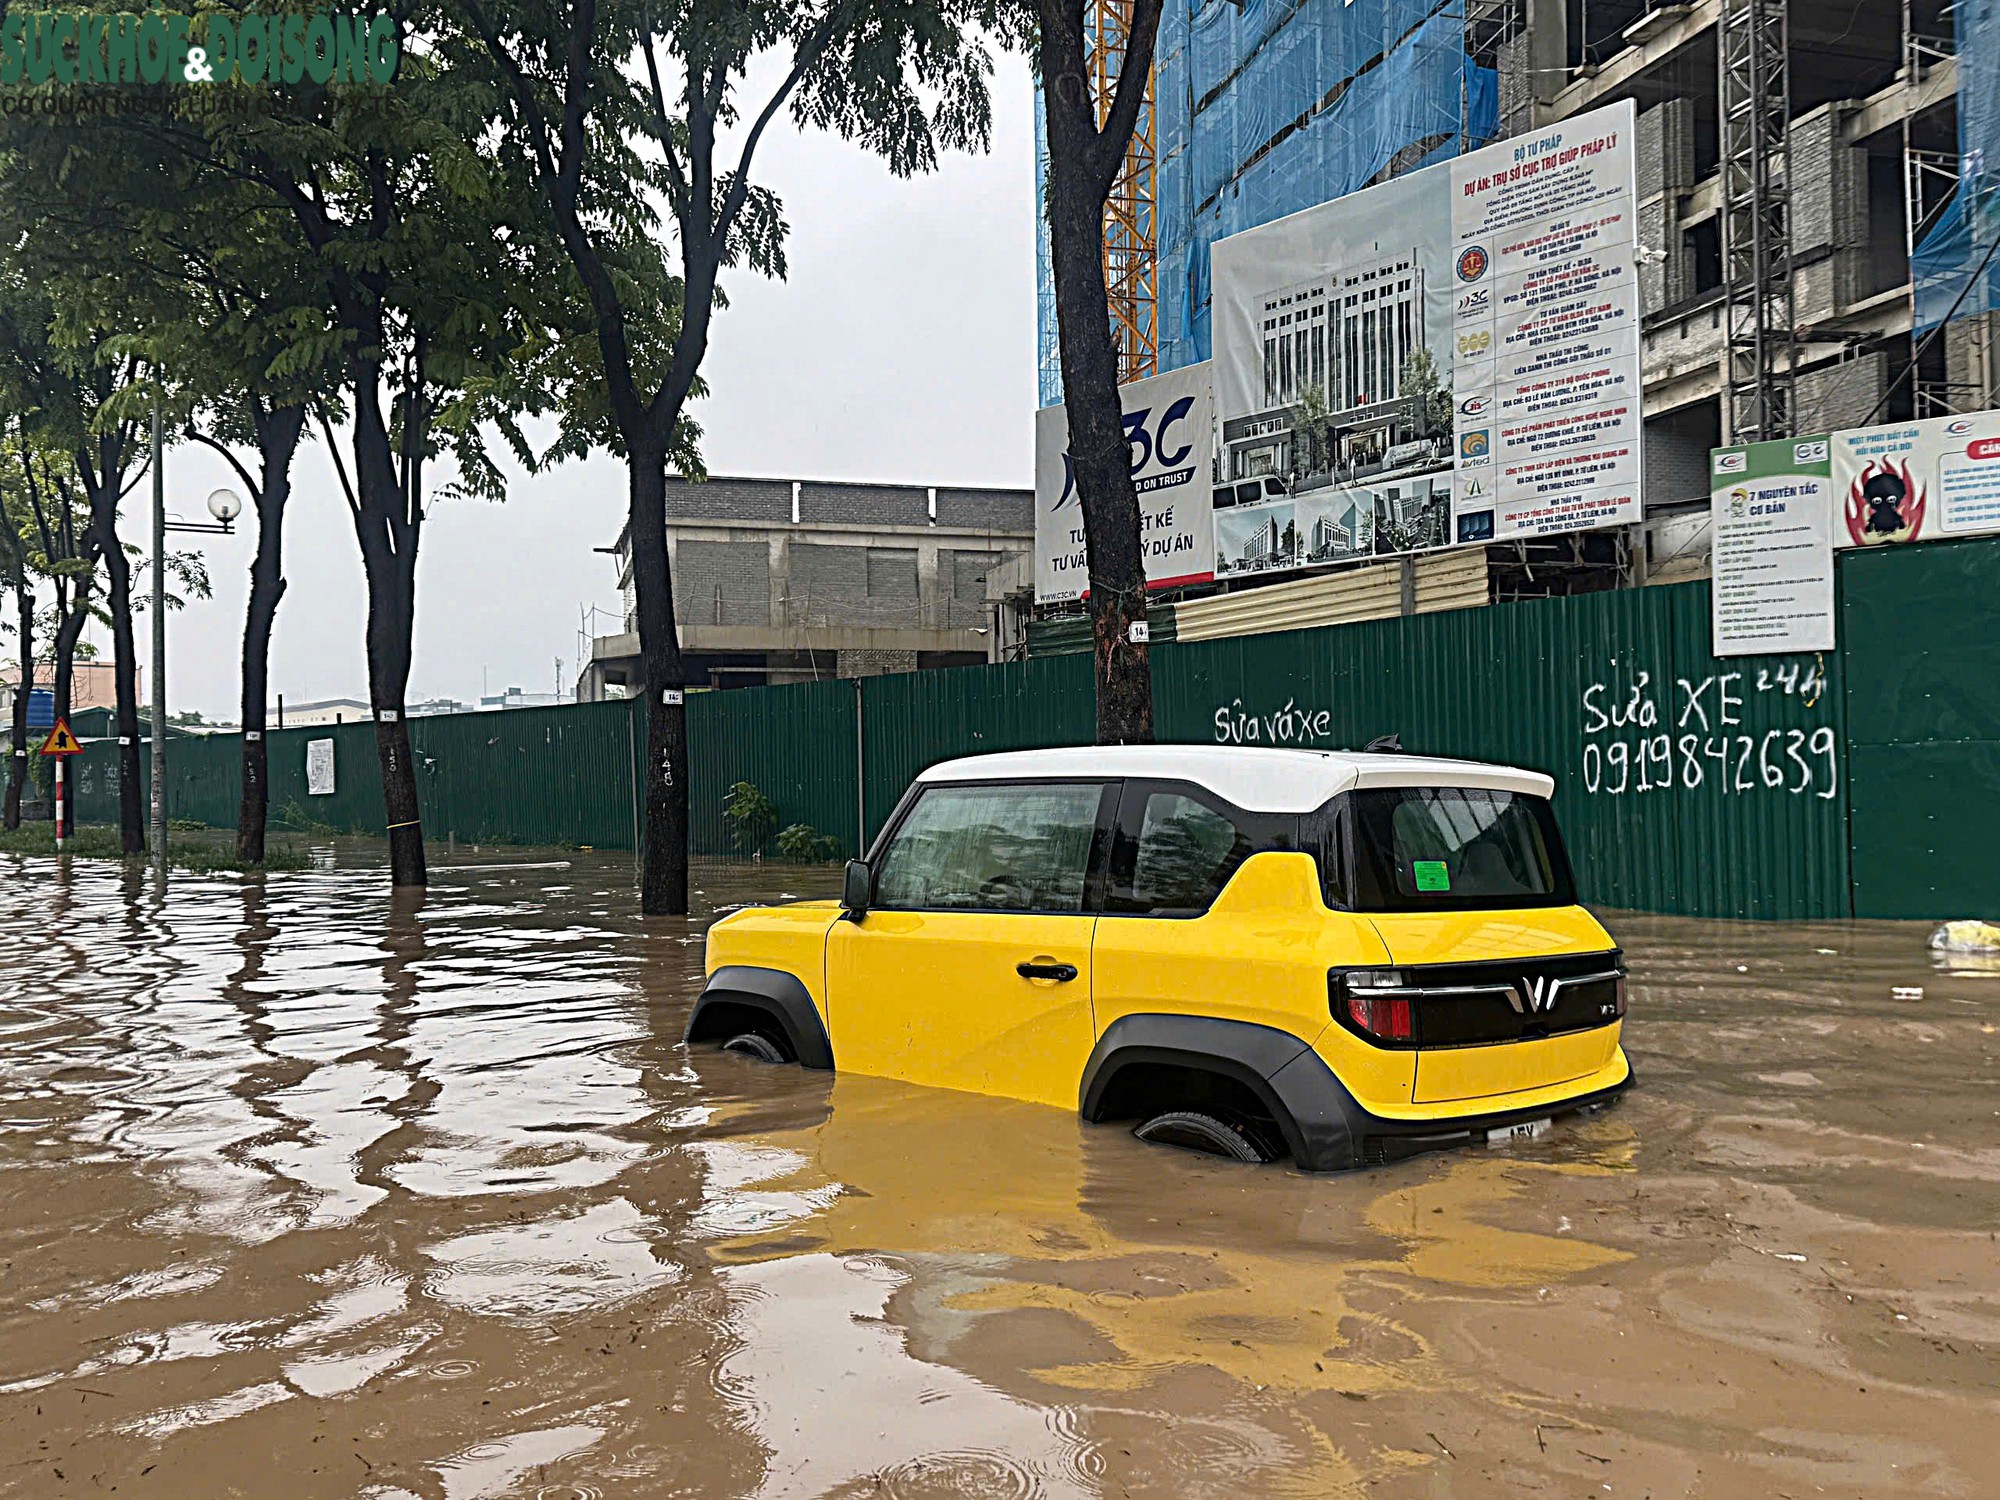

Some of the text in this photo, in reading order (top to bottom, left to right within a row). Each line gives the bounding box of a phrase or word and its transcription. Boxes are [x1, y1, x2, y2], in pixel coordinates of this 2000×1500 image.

[1464, 130, 1616, 198] DỰ ÁN: TRỤ SỞ CỤC TRỢ GIÚP PHÁP LÝ
[1514, 132, 1561, 164] BỘ TƯ PHÁP
[1144, 479, 1156, 490] ON
[1159, 471, 1188, 487] TRUST
[1749, 481, 1818, 501] 7 NGUYÊN TẮC
[1156, 505, 1174, 528] KẾ
[1749, 501, 1786, 516] CƠ BẢN
[1052, 554, 1069, 571] TƯ
[1153, 536, 1172, 557] DỰ
[1174, 533, 1193, 552] ÁN
[1583, 671, 1657, 733] Sửa
[1677, 672, 1743, 732] XE
[1583, 727, 1837, 799] 0919842639
